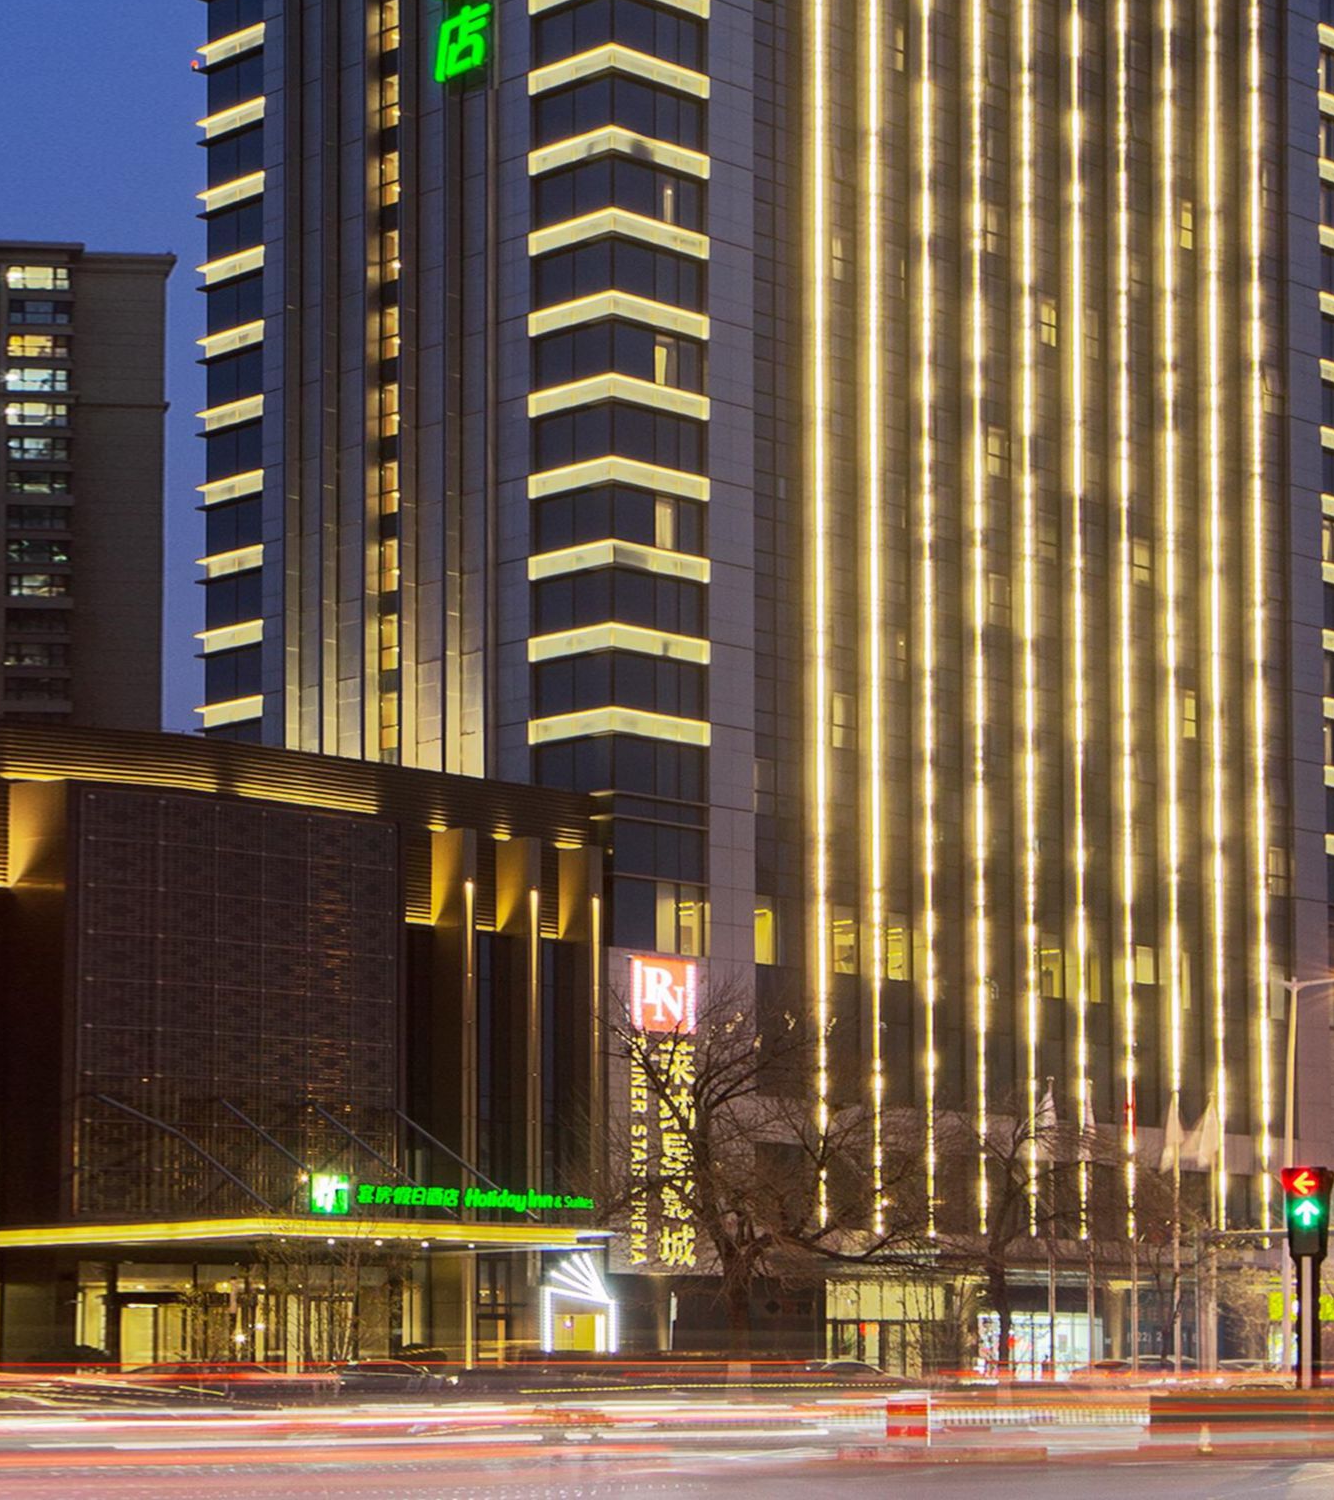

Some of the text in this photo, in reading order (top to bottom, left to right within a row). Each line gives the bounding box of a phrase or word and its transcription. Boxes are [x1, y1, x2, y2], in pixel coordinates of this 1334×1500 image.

[630, 1123, 648, 1177] STAR
[356, 1184, 460, 1208] 套房假日酒店
[463, 1187, 527, 1211] Holiday
[527, 1188, 554, 1209] Inn
